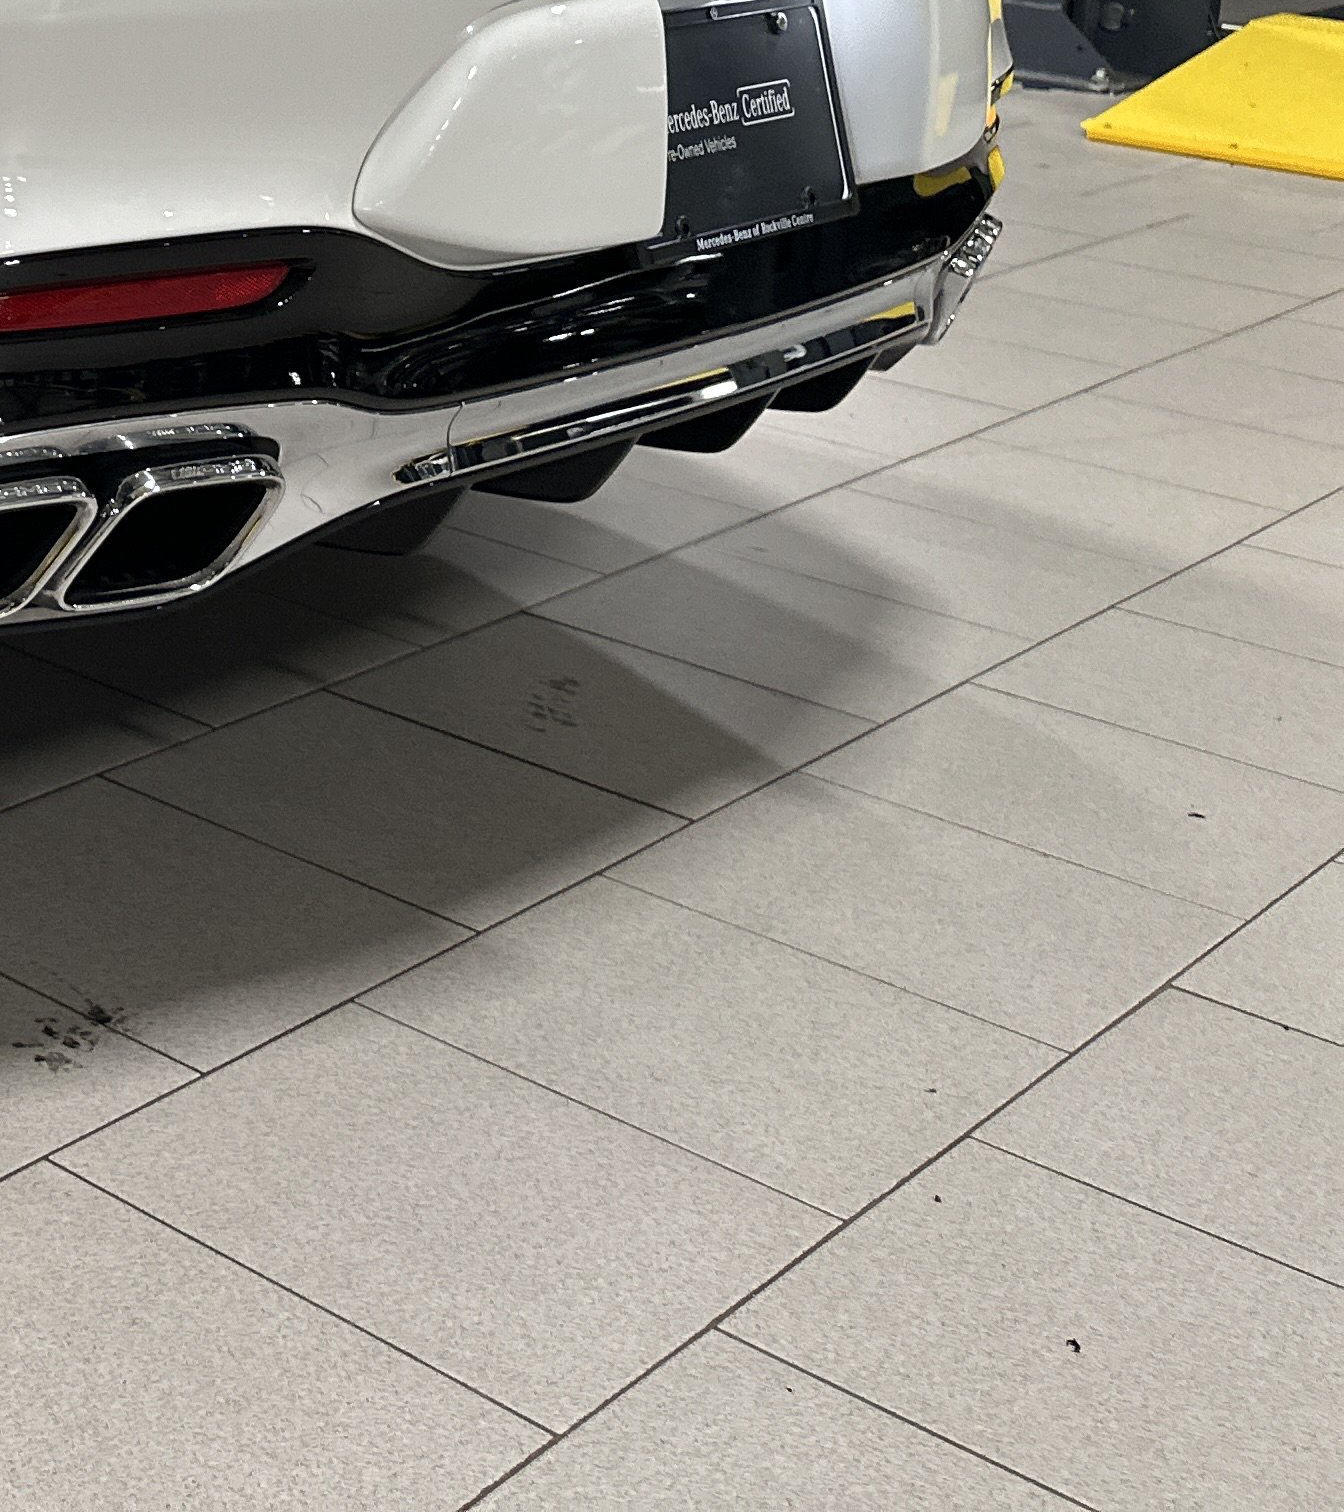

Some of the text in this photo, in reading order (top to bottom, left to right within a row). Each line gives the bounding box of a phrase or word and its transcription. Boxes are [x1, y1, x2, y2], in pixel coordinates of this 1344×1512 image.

[667, 86, 791, 134] ercedes-Benz Certified
[667, 134, 737, 162] re-Owned Vehicles
[696, 228, 752, 251] Mercedes-Benz
[752, 223, 761, 237] of
[760, 216, 792, 235] Rockville
